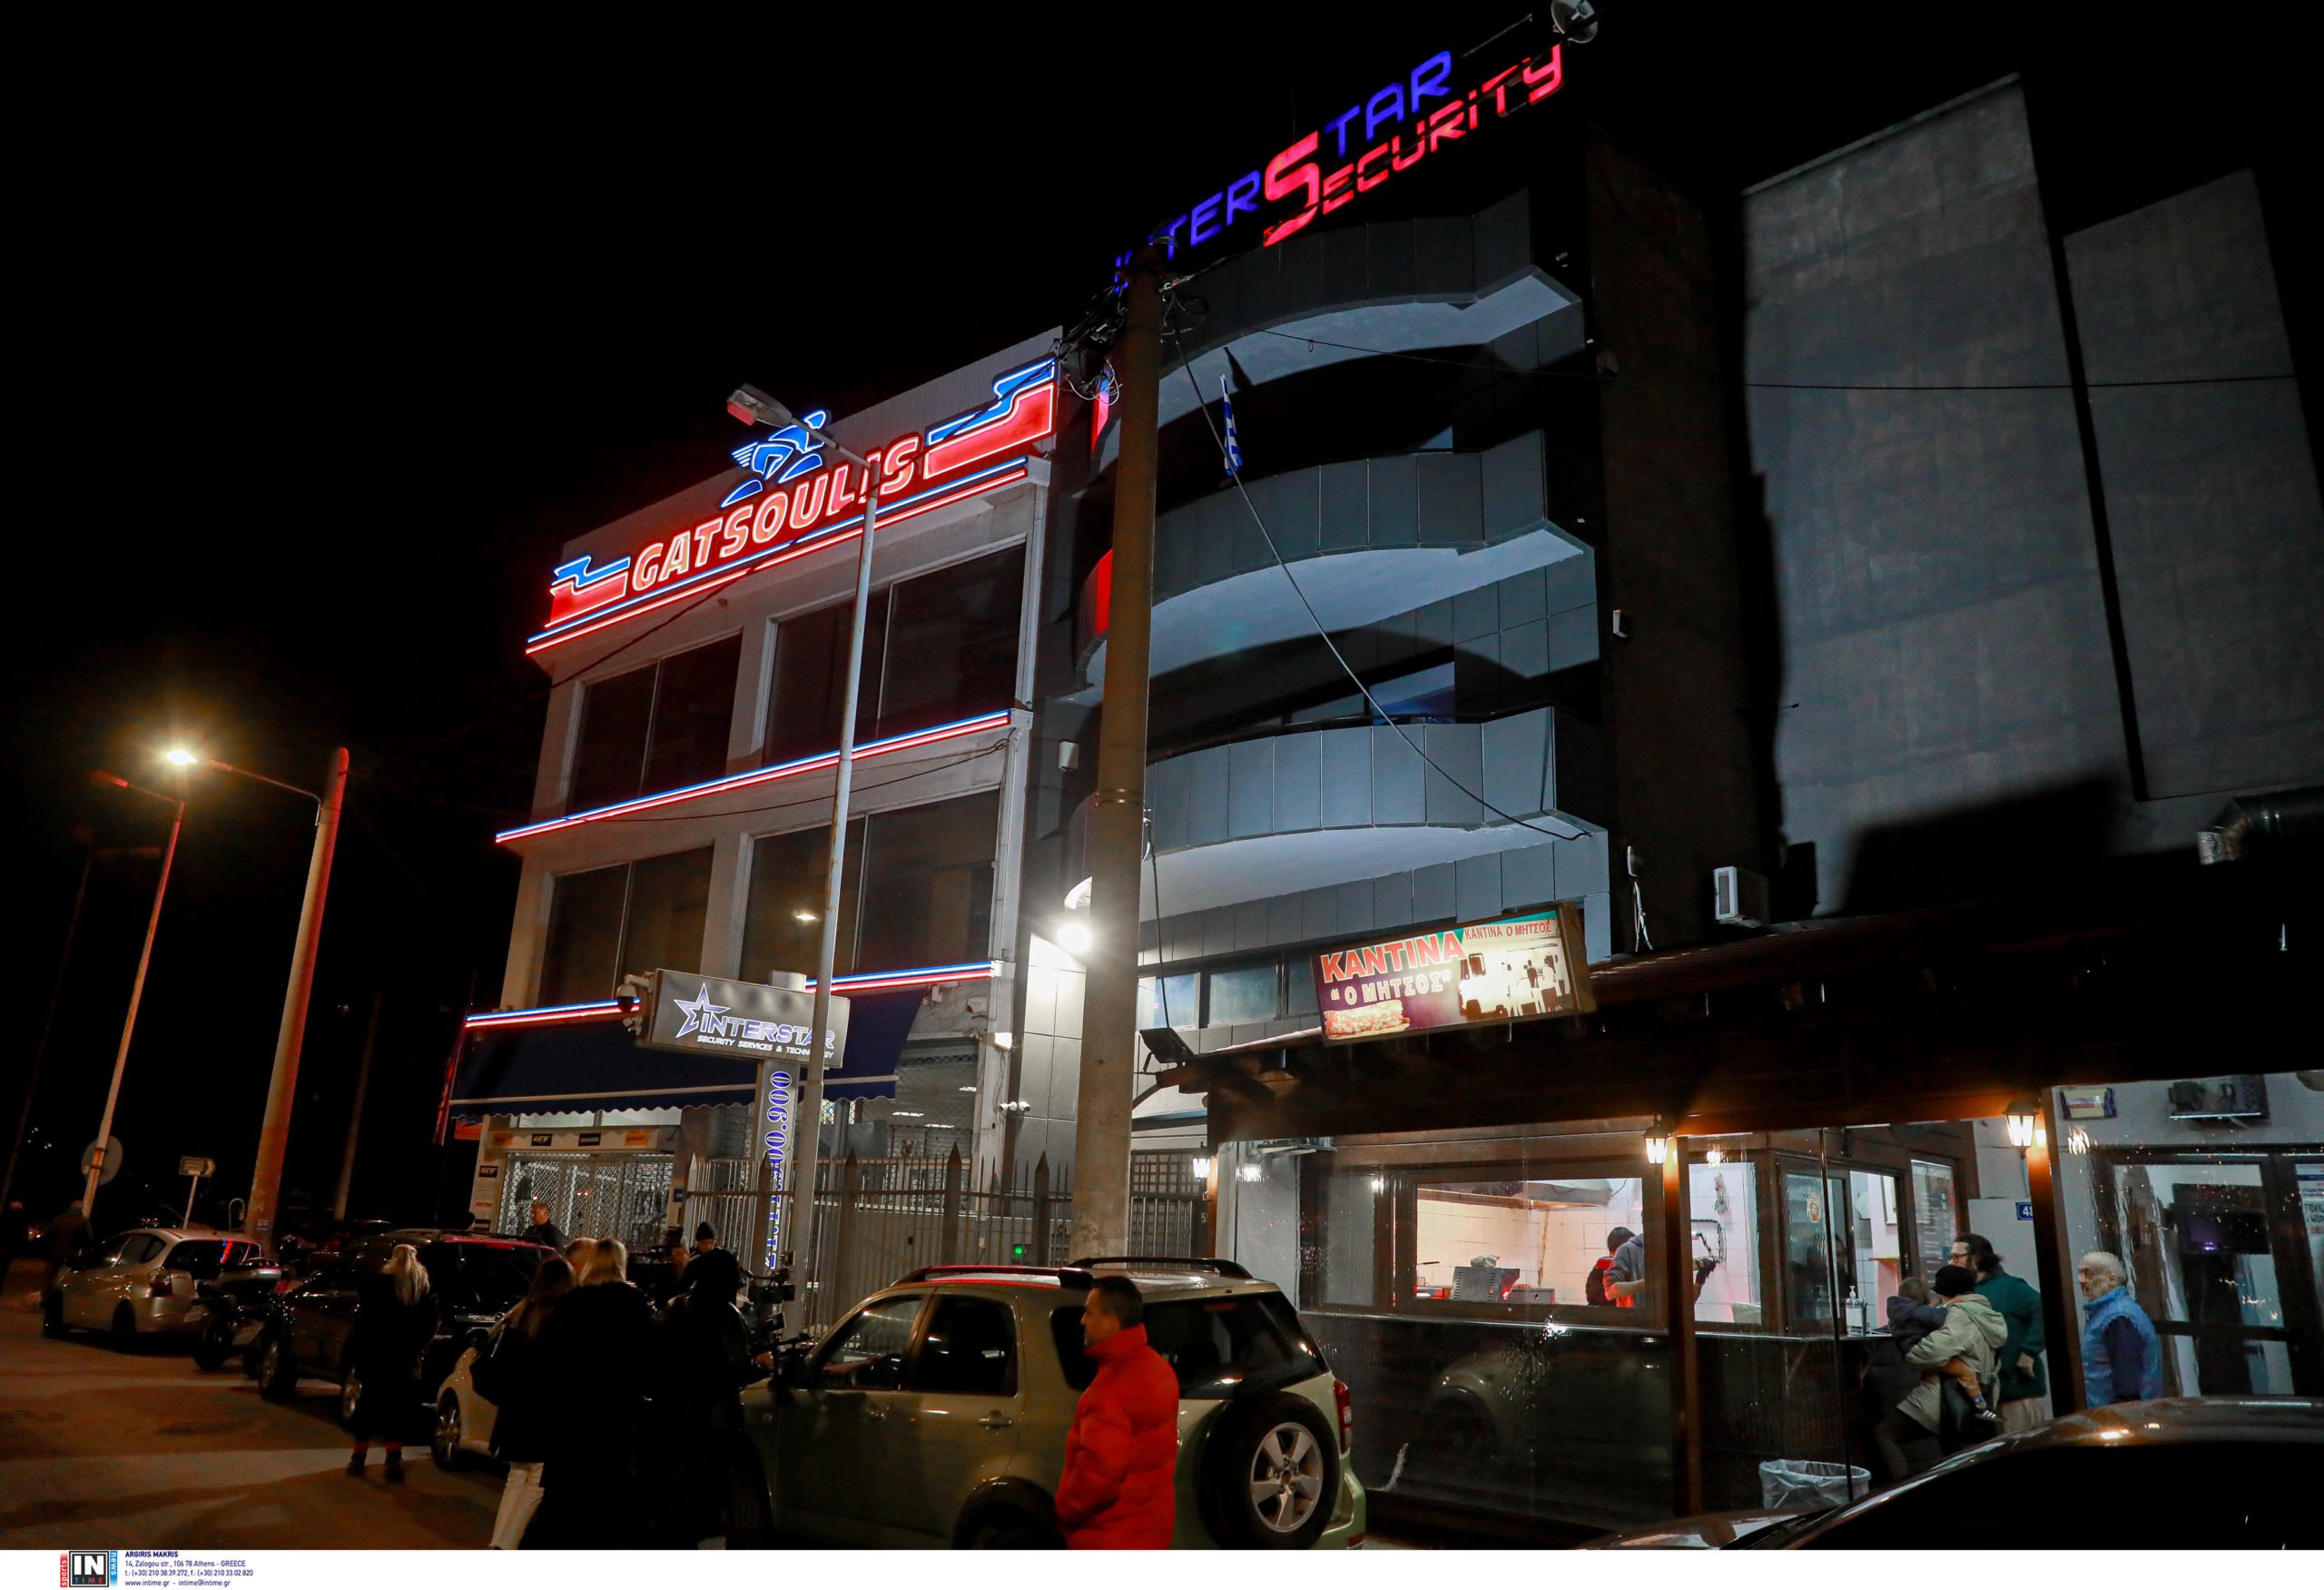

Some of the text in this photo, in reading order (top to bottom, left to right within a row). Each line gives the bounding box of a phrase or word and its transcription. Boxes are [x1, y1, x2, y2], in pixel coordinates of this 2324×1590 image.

[1264, 44, 1563, 247] SECURITY
[697, 1035, 735, 1046] SECURITY
[737, 1041, 773, 1052] SERVICES
[786, 1046, 834, 1059] TECHNGY
